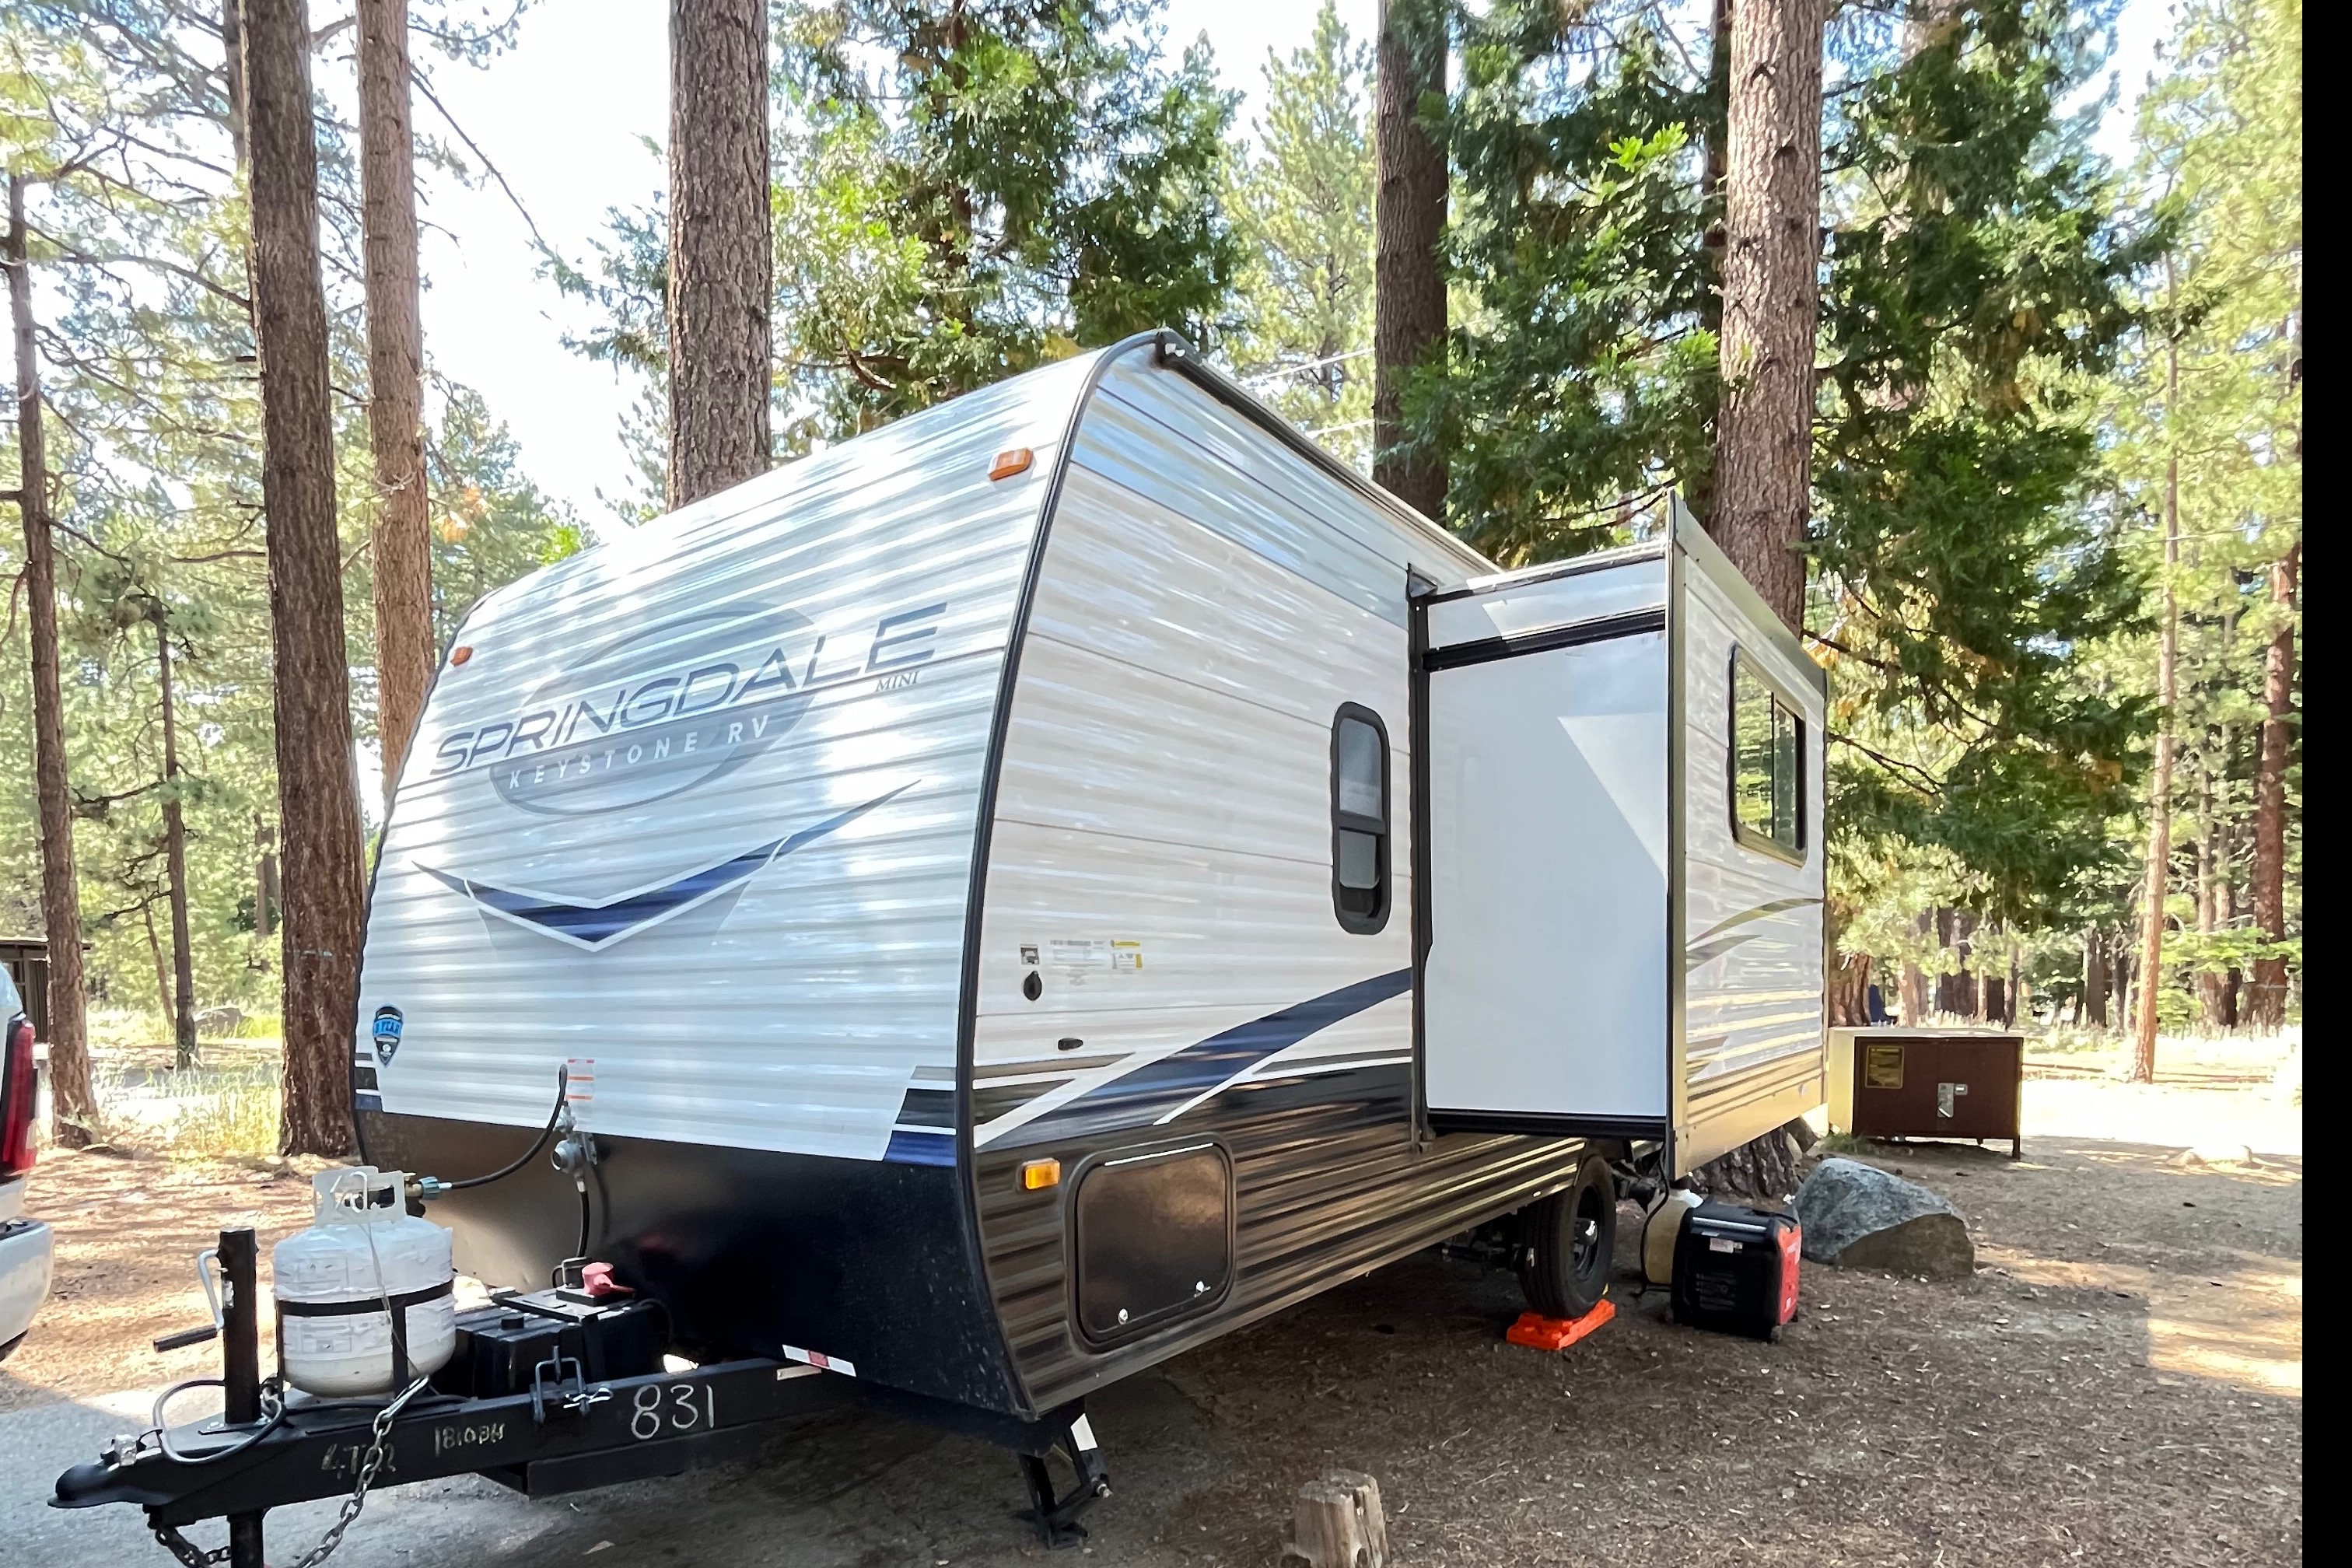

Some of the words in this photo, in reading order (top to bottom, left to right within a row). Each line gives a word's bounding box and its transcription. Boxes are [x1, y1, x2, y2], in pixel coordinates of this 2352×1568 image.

[430, 602, 947, 775] SPRINGDALE
[875, 670, 919, 692] MINI
[509, 731, 698, 789] KEYSTONE
[726, 715, 769, 744] RV
[631, 1384, 715, 1440] 831
